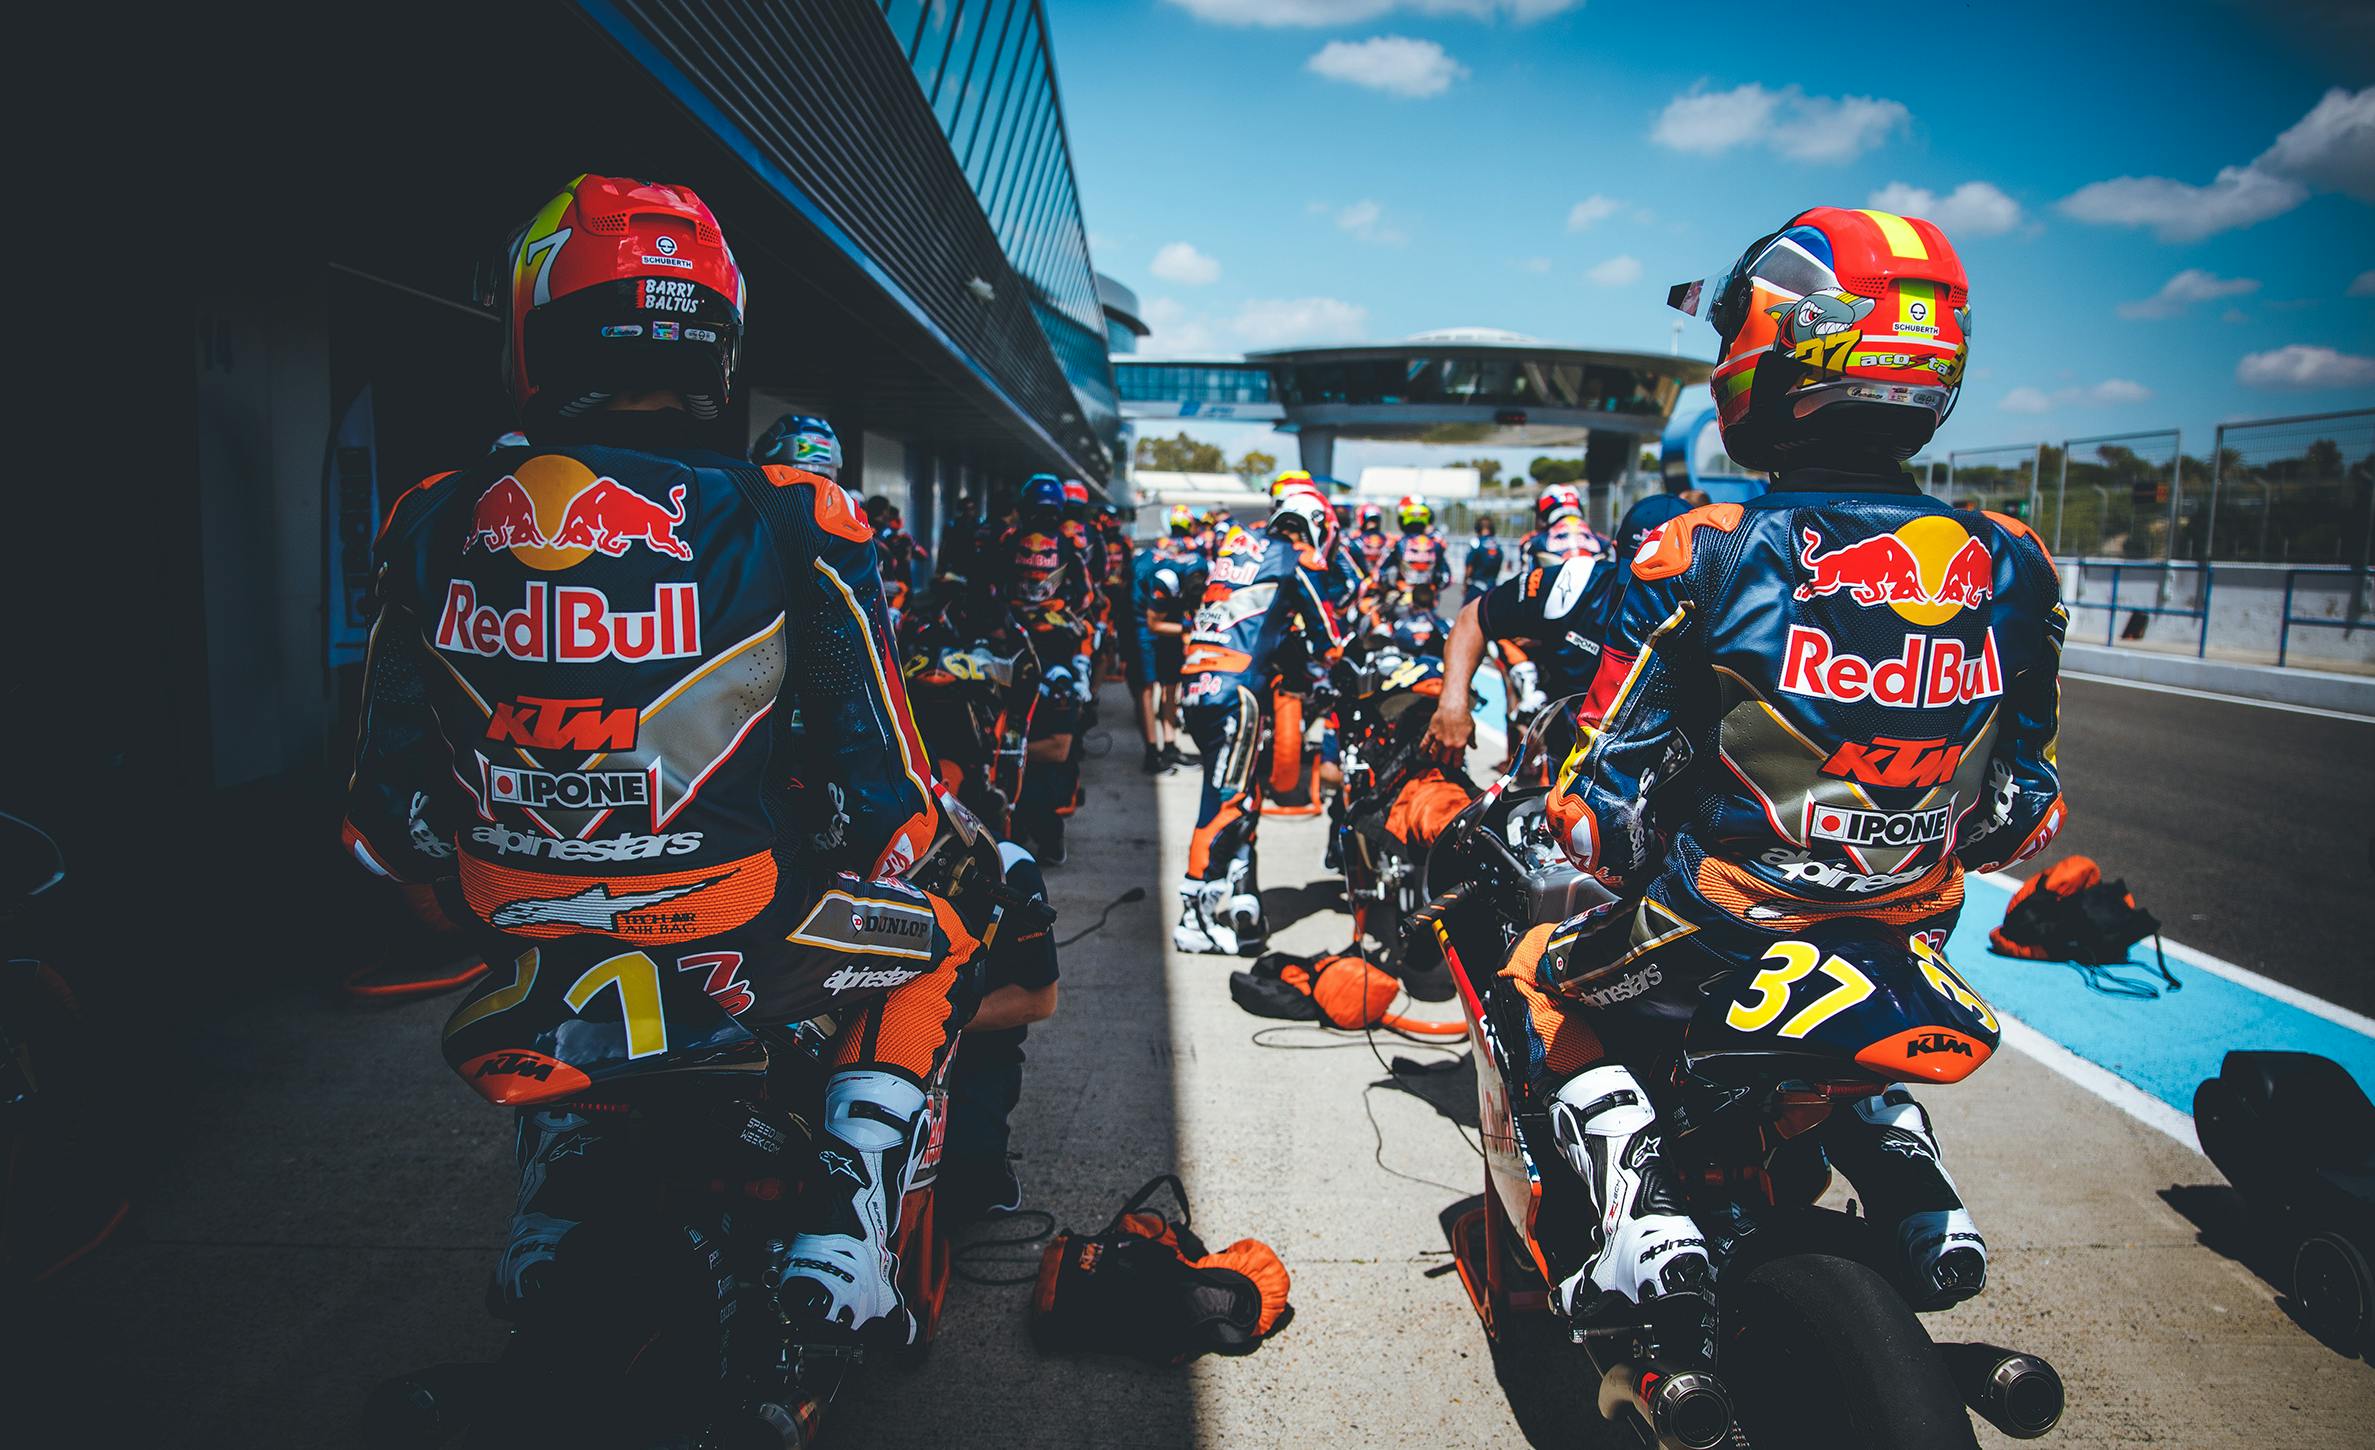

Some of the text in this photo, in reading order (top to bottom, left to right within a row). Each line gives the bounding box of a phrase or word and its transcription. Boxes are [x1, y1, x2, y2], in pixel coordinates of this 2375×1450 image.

[643, 256, 692, 268] SCHUBERTH
[645, 279, 696, 298] BARRY
[645, 295, 699, 313] BALTUS
[1894, 323, 1939, 335] SCHUBERTH
[436, 579, 702, 663] Red Bull
[1778, 623, 1927, 709] Red
[486, 696, 640, 751] KTM
[1818, 736, 1964, 788] KTM
[519, 771, 648, 806] IPONE
[1847, 806, 1950, 846] IPONE
[472, 823, 704, 863] alpinestars
[625, 924, 697, 934] AIR BAG
[864, 915, 929, 938] DUNLOP
[1725, 940, 1877, 1039] 37
[1906, 1033, 1973, 1059] KTM
[475, 1053, 554, 1083] KTM
[747, 1116, 776, 1139] SPEED
